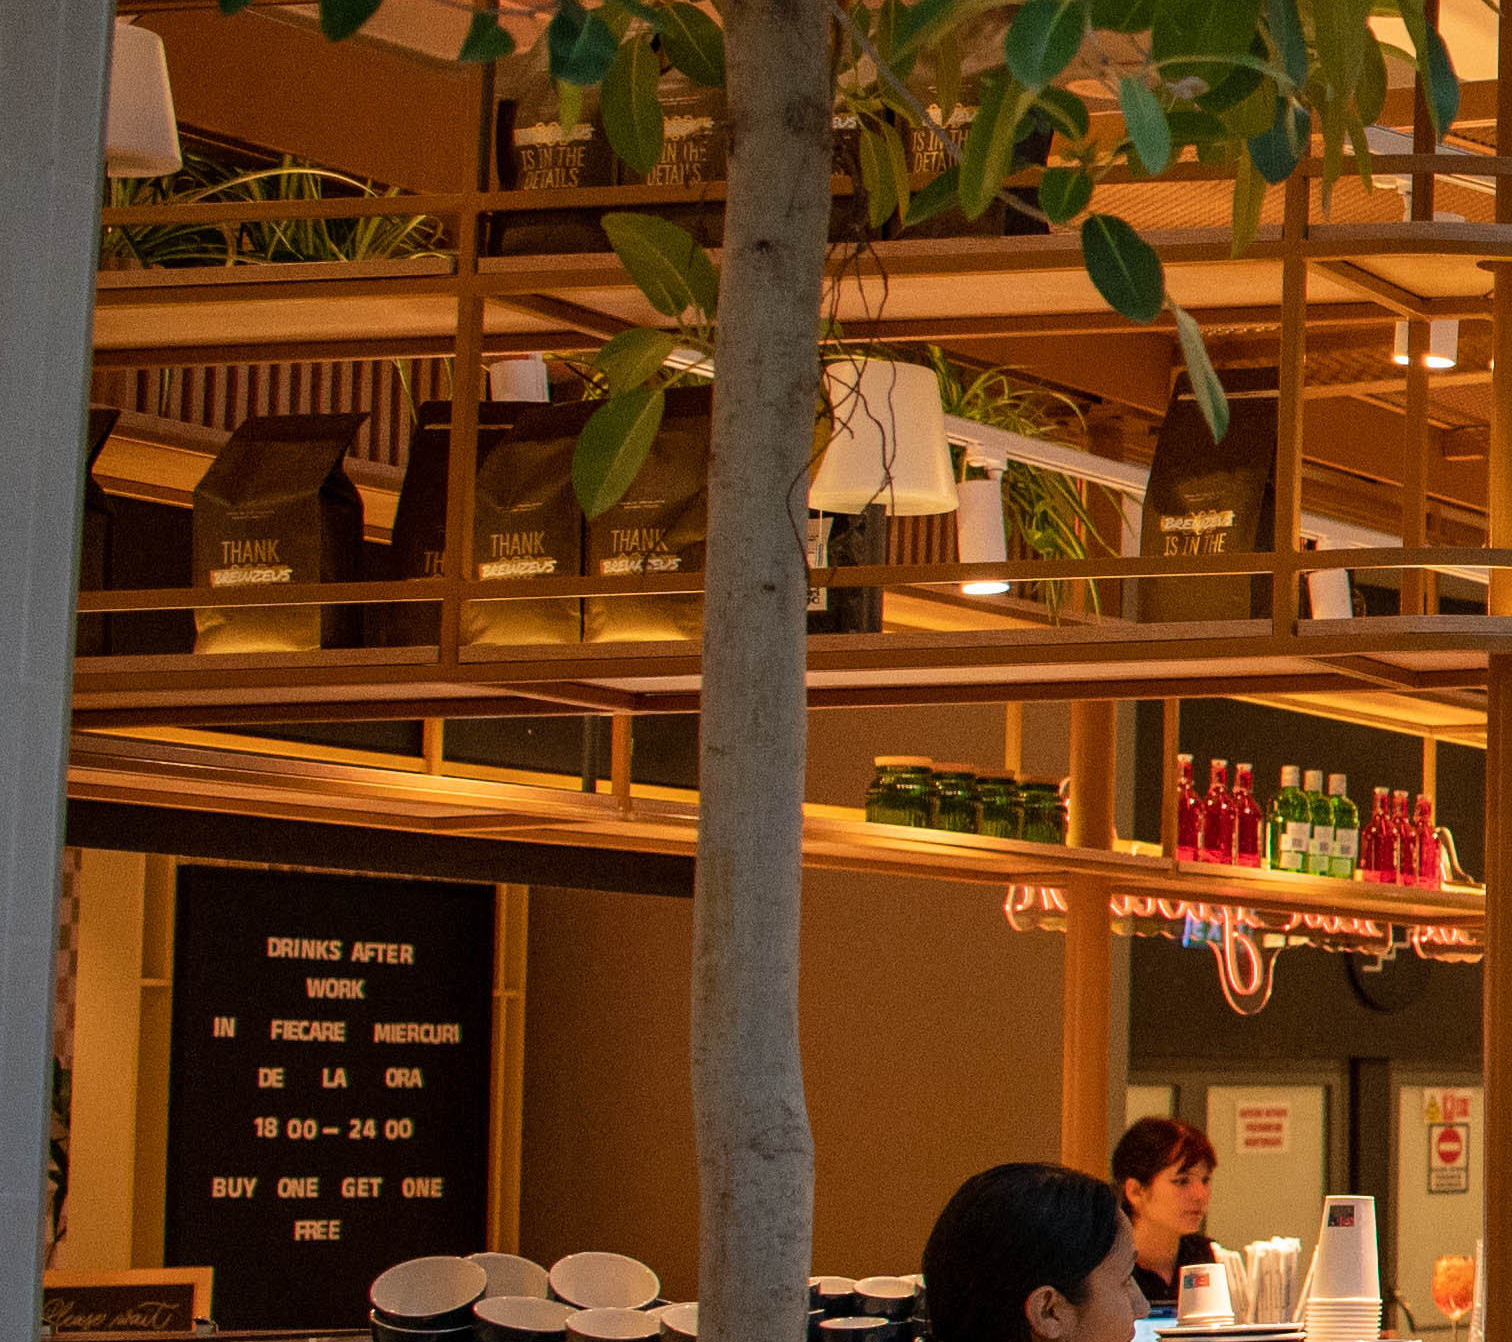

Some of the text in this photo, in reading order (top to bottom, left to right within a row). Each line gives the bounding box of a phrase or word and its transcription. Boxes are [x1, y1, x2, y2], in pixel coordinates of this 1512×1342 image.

[221, 539, 280, 564] THANK
[490, 530, 545, 557] THANK
[611, 527, 669, 554] THANK
[266, 936, 415, 965] DRINKS AFTER
[305, 977, 367, 1000] WORK
[213, 1016, 461, 1045] IN FIECARE MIERCURI
[257, 1066, 424, 1089] DE LA ORA
[253, 1116, 279, 1139] 18
[286, 1117, 318, 1141] 00
[348, 1117, 377, 1140] 24
[384, 1117, 414, 1141] 00
[211, 1176, 444, 1199] BUY ONE GET ONE
[293, 1219, 341, 1242] FREE
